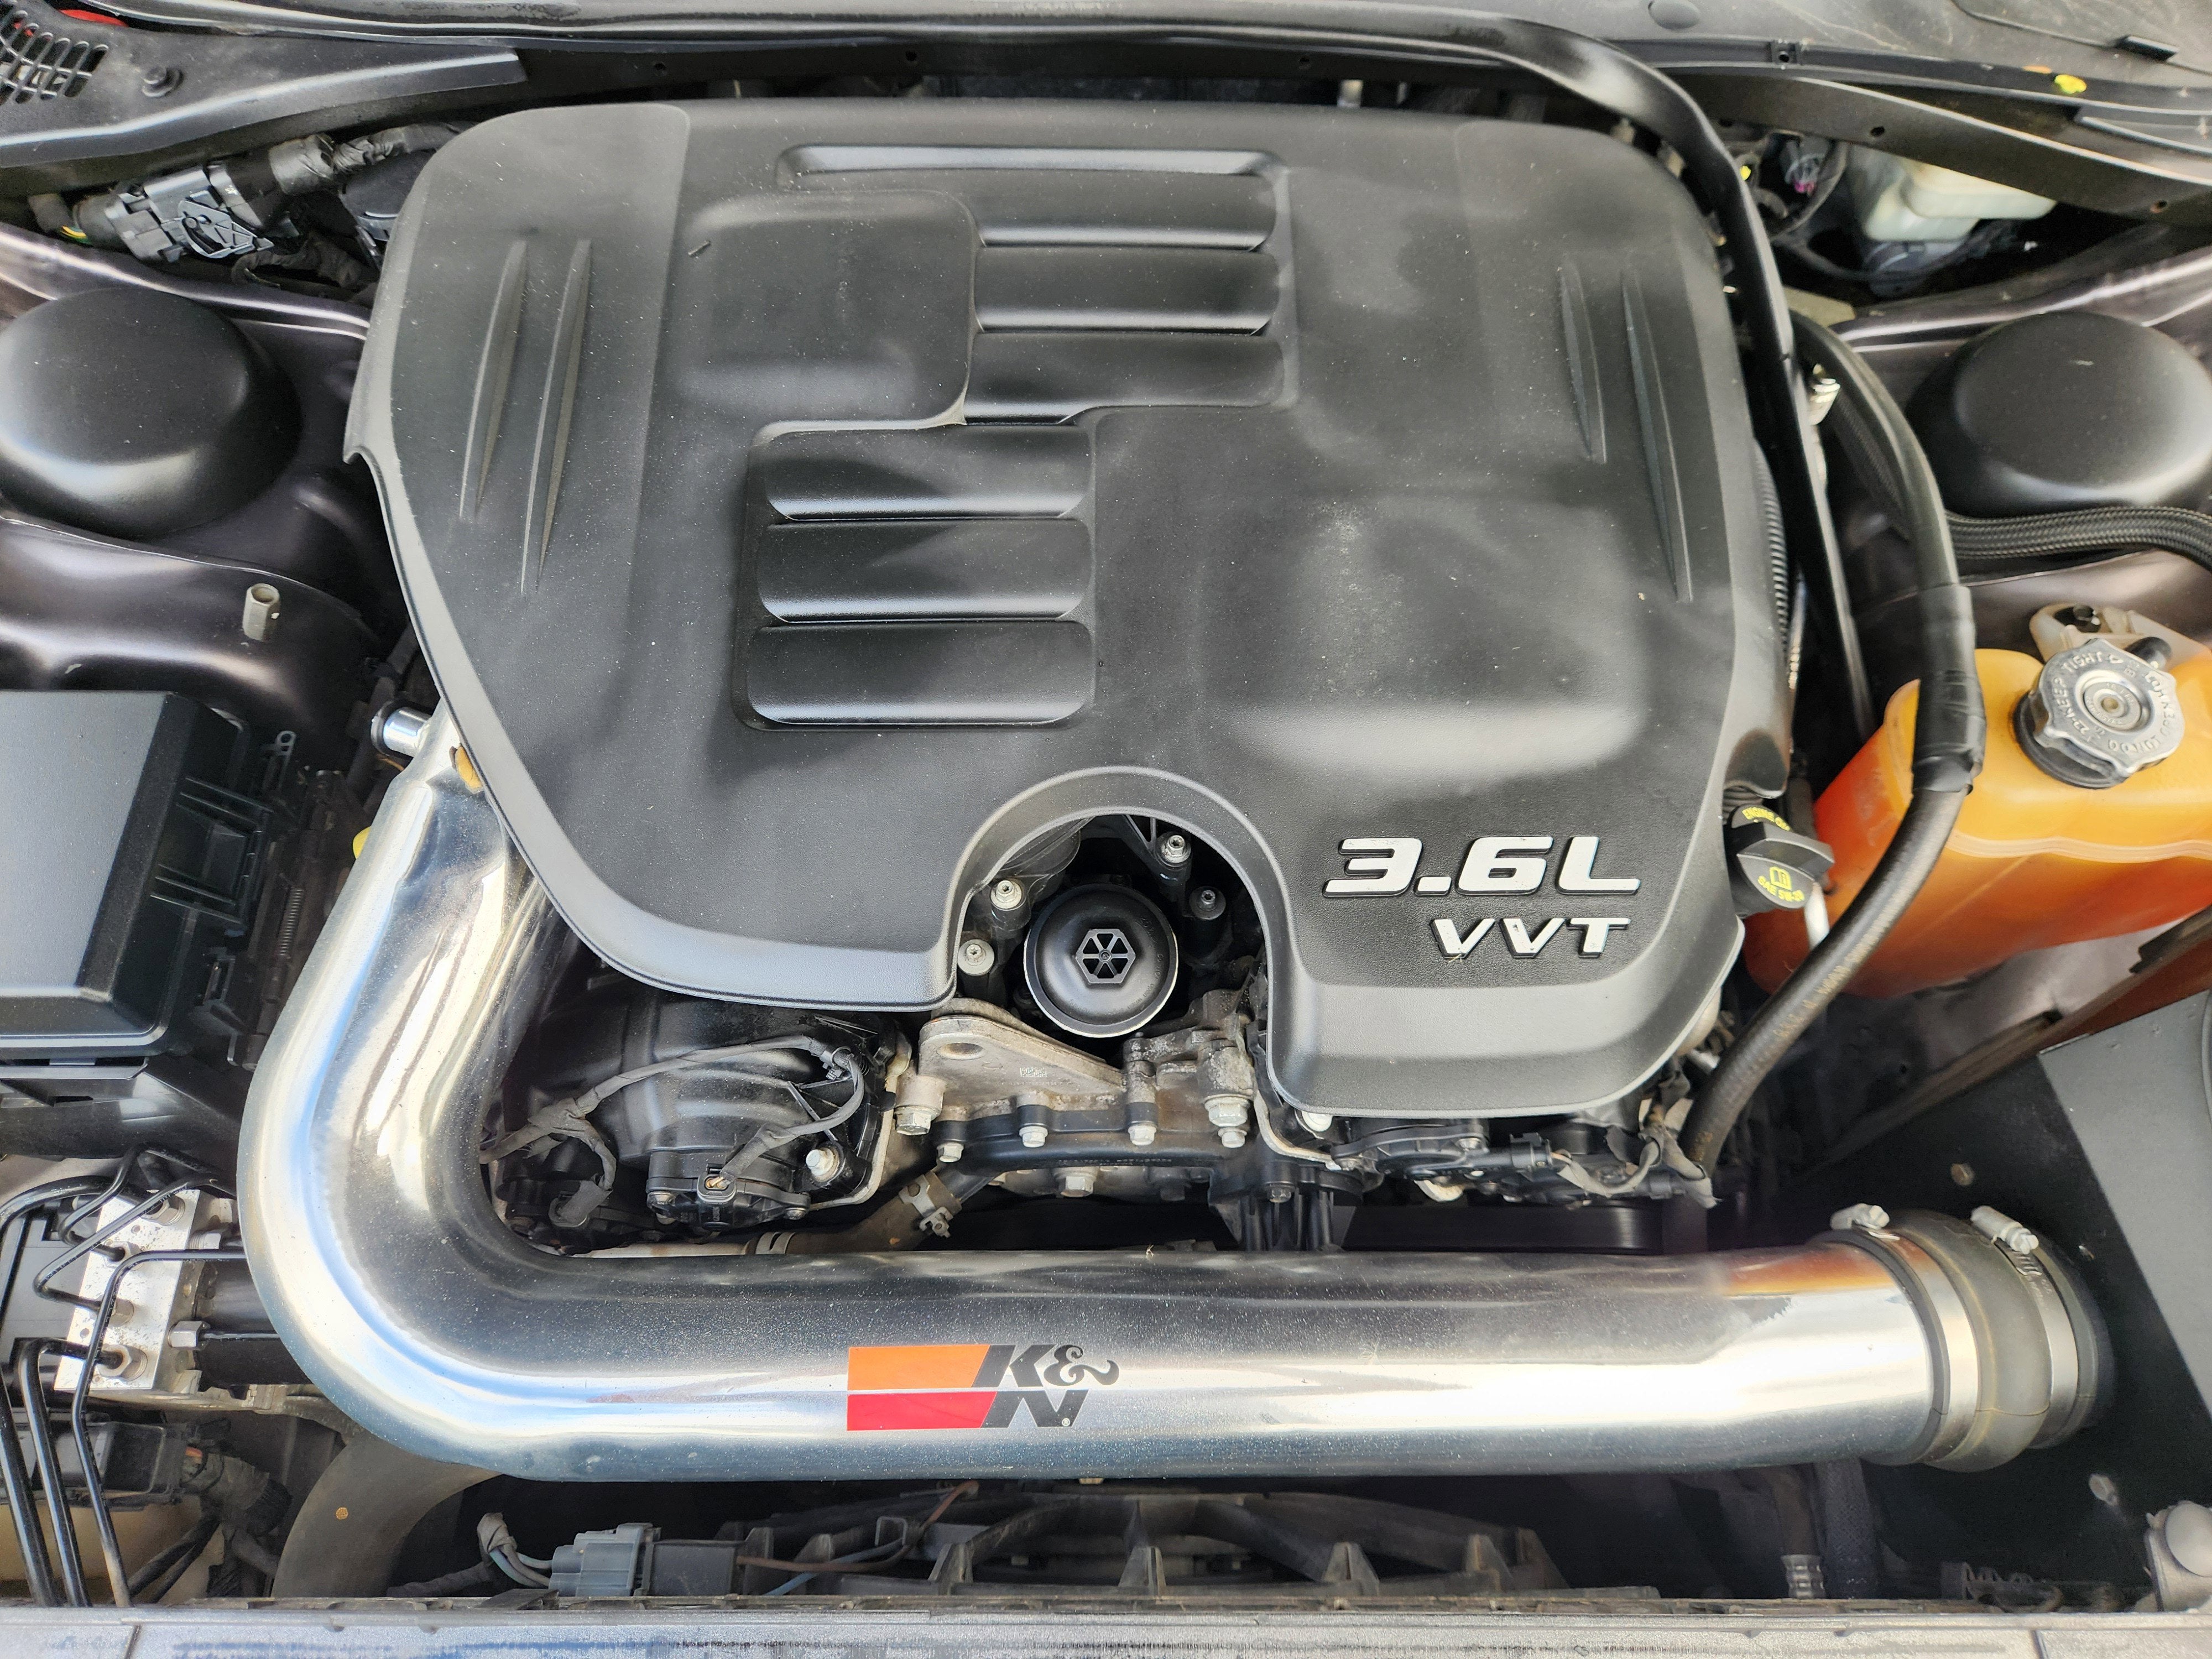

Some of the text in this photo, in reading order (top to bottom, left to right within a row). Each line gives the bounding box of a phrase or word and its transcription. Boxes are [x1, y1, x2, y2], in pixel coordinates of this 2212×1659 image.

[2052, 651, 2103, 718] KEEP TIGHT
[1742, 807, 1775, 823] ENGINE
[1323, 836, 1642, 896] 3.6L
[1757, 875, 1777, 896] SAE
[1430, 917, 1632, 959] VVT
[972, 1343, 1119, 1428] K&N
